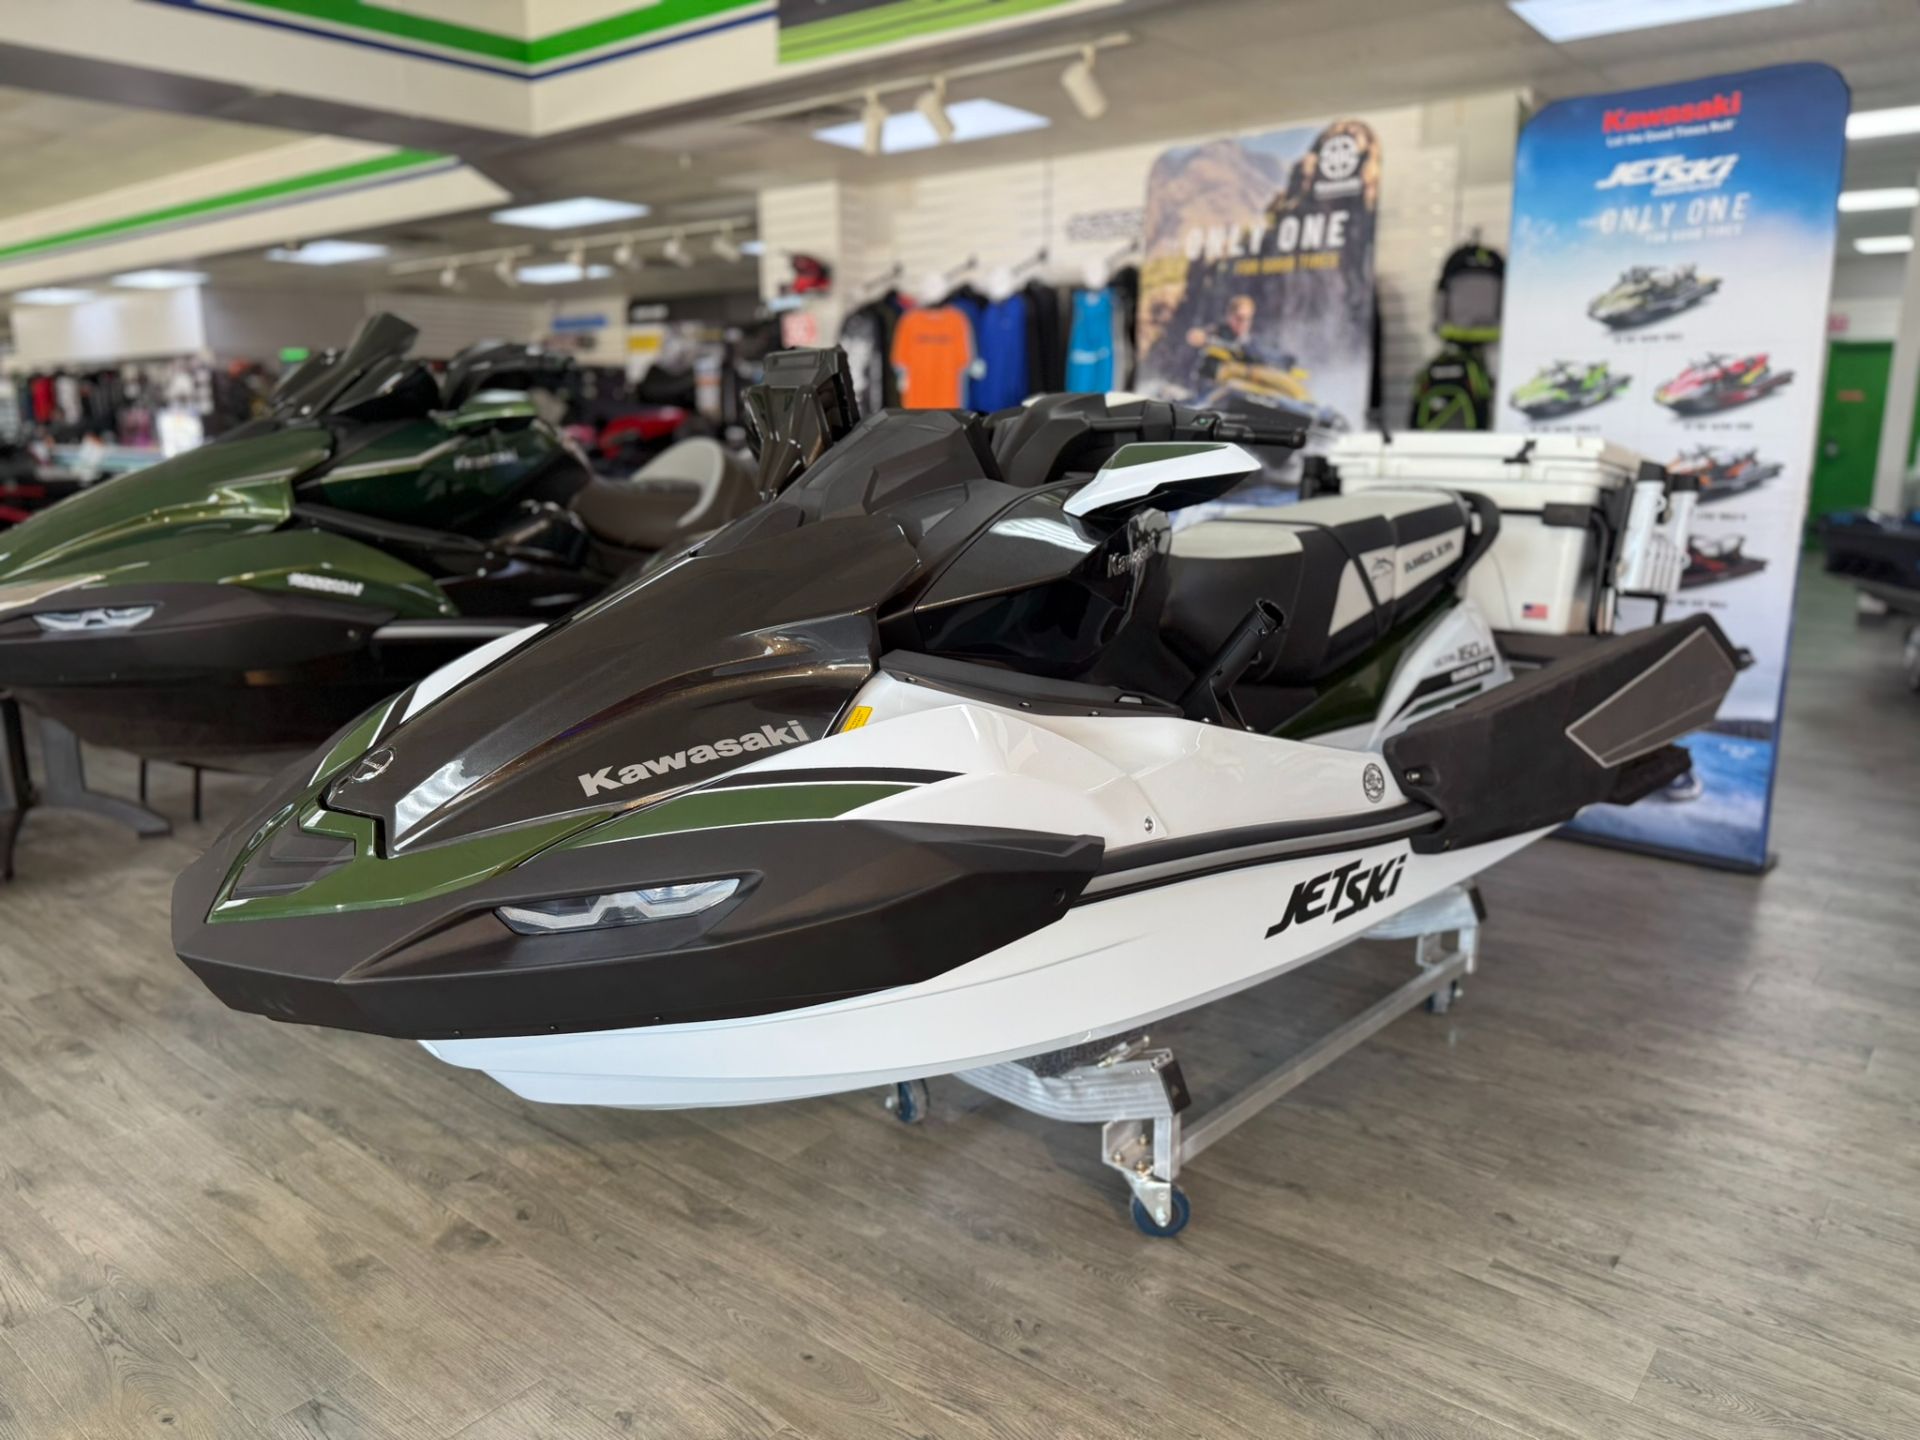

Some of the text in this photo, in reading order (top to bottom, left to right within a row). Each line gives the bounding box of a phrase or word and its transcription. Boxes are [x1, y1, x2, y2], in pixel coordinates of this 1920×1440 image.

[1687, 192, 1752, 227] ONE
[1277, 210, 1351, 252] ONE
[577, 719, 811, 798] Kawasaki
